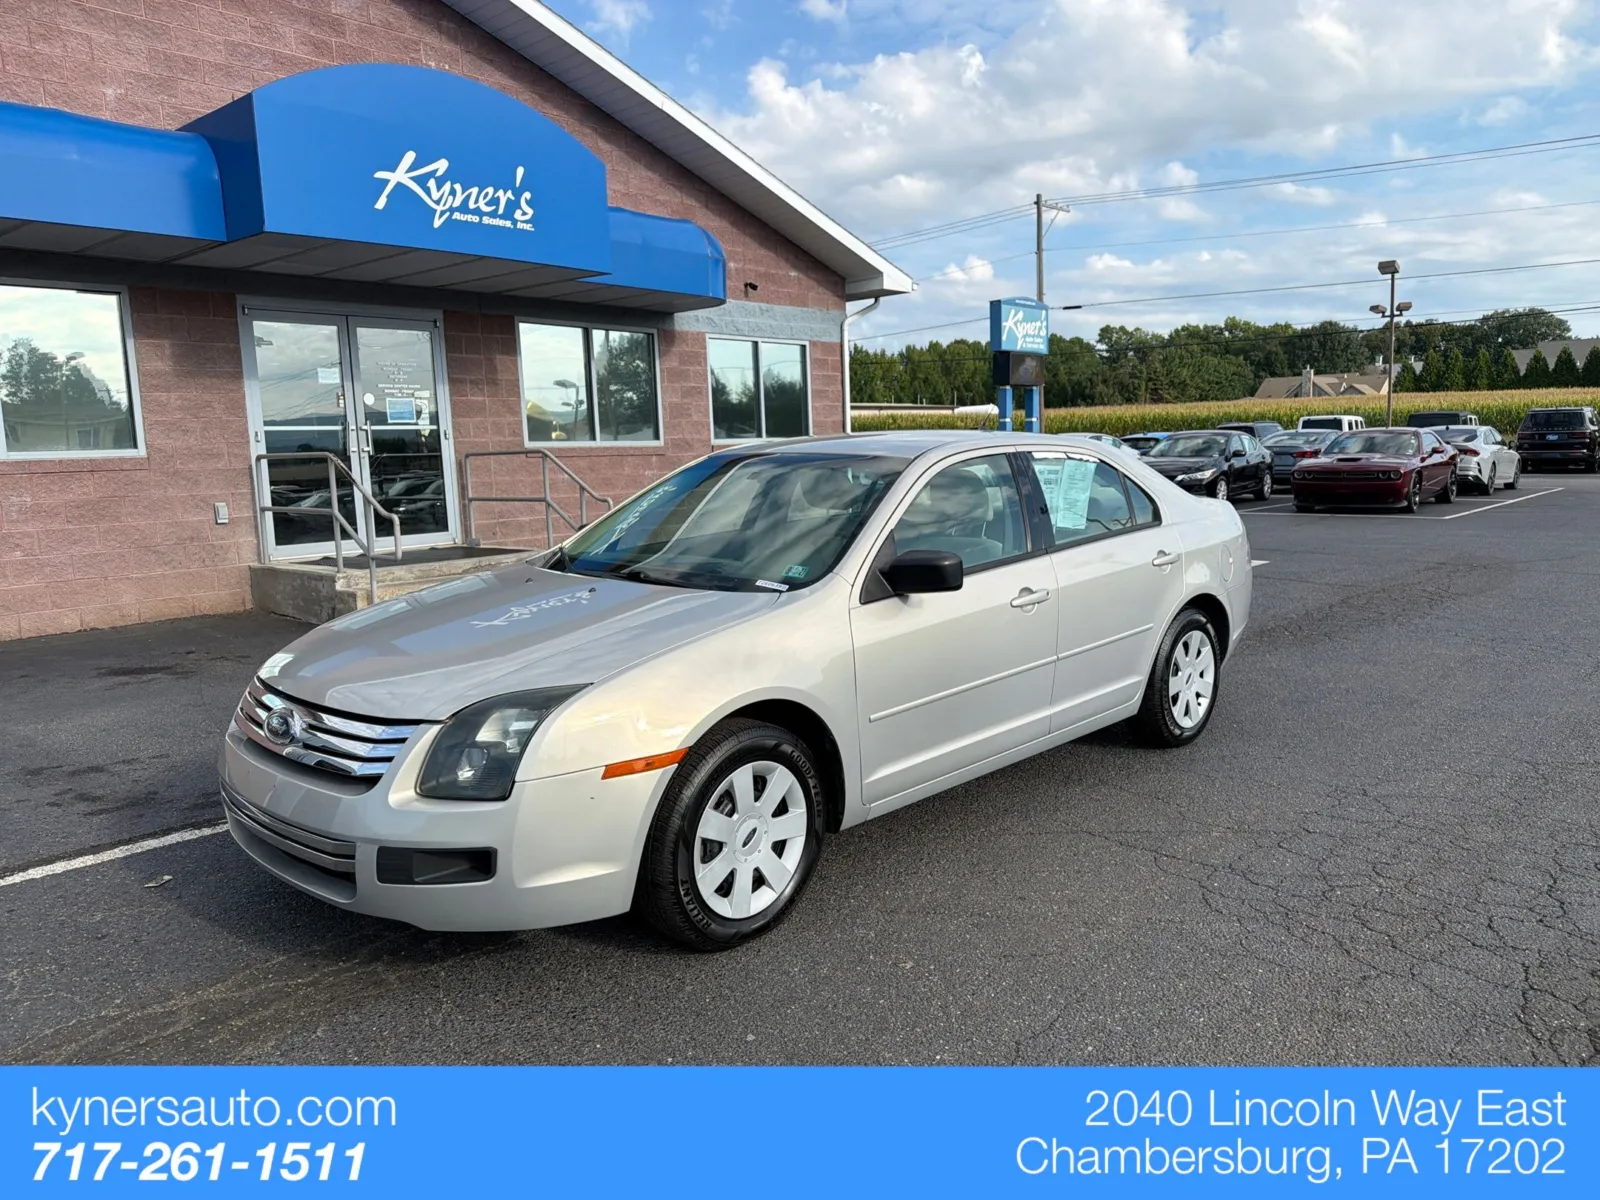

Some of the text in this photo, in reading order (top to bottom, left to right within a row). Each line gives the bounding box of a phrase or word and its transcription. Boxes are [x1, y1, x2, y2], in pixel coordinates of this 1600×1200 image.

[373, 150, 534, 229] Kyner's
[452, 211, 535, 231] Auto Sales, Inc.
[1002, 308, 1047, 350] Kyner's
[680, 878, 712, 931] RELIANT
